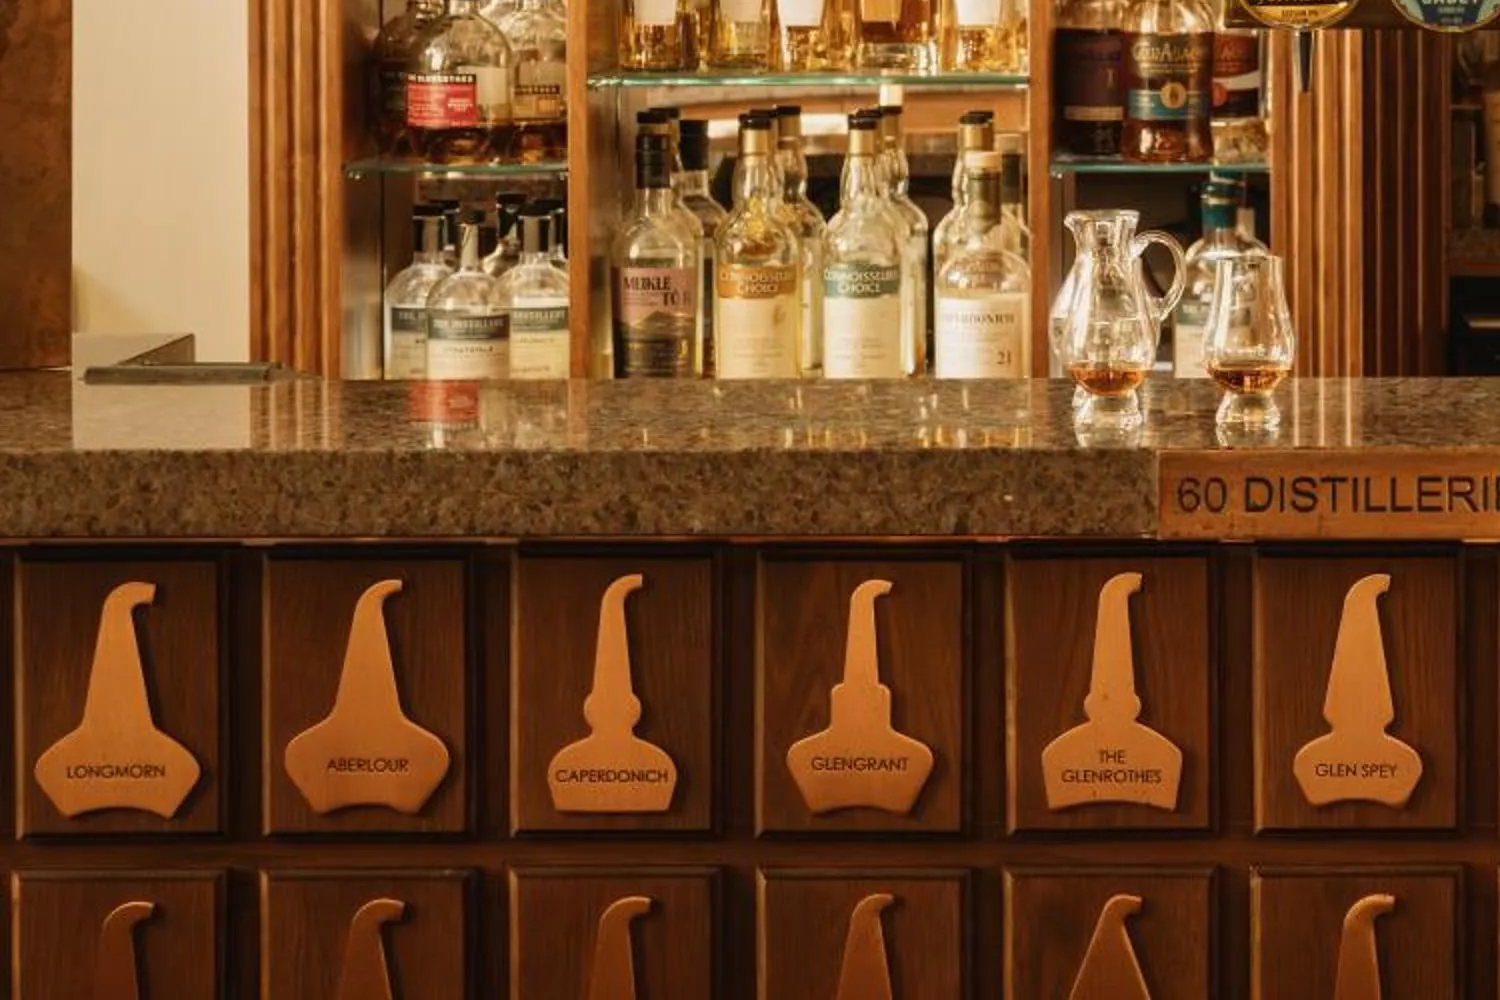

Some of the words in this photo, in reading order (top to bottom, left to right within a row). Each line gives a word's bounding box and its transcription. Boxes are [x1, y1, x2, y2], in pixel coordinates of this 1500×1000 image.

[996, 351, 1012, 365] 21
[1176, 475, 1228, 513] 60
[811, 755, 910, 773] GLENGRANT
[1097, 749, 1126, 765] THE
[66, 764, 167, 780] LONGMORN
[326, 757, 410, 774] ABERLOUR
[1314, 763, 1358, 779] GLEN
[1361, 763, 1399, 779] SPEY
[555, 768, 669, 784] CAPERDONICH
[1060, 768, 1163, 785] GLENROTHES
